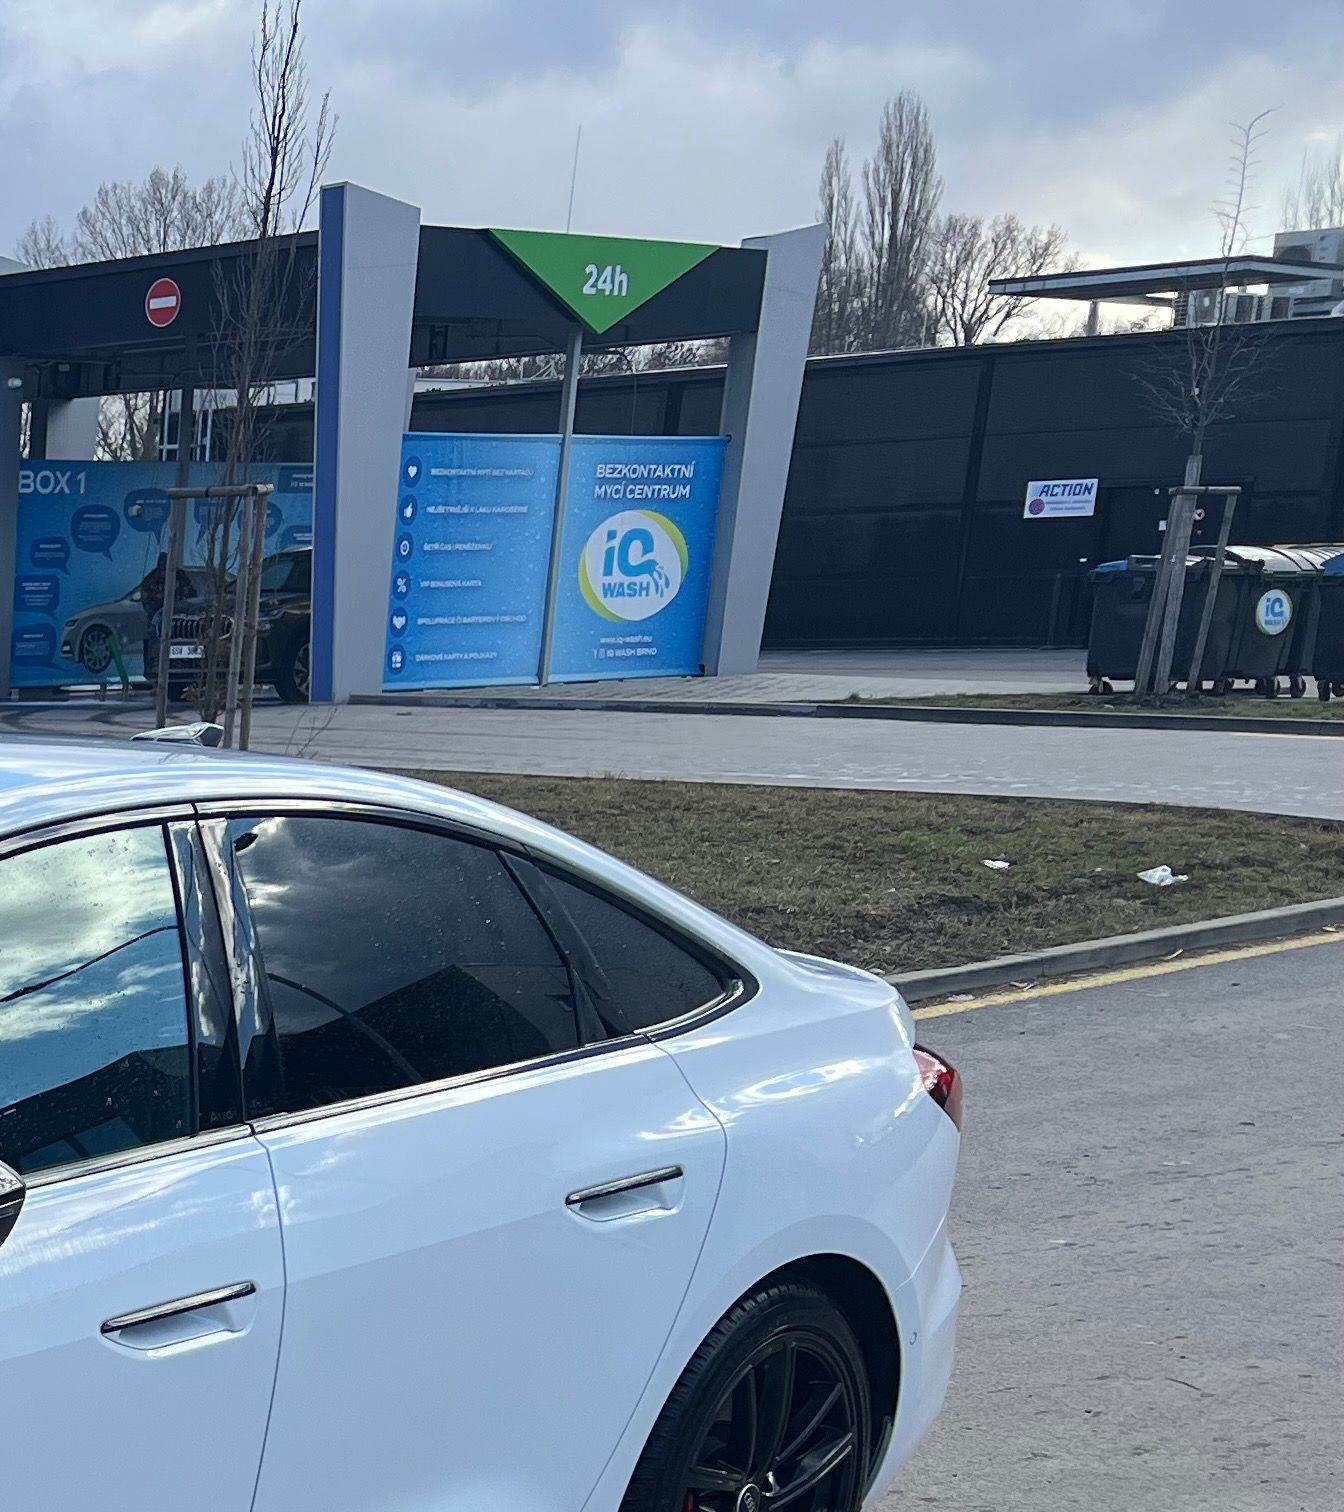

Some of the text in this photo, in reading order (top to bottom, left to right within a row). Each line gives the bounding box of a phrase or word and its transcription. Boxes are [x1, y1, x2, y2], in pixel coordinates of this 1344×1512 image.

[582, 263, 629, 297] 24h
[596, 460, 696, 479] BEZKONTAKTNÍ
[18, 470, 86, 494] BOX 1
[594, 480, 691, 499] MYCÍ CENTRUM
[1038, 483, 1094, 498] ACTION
[602, 582, 650, 598] WASH
